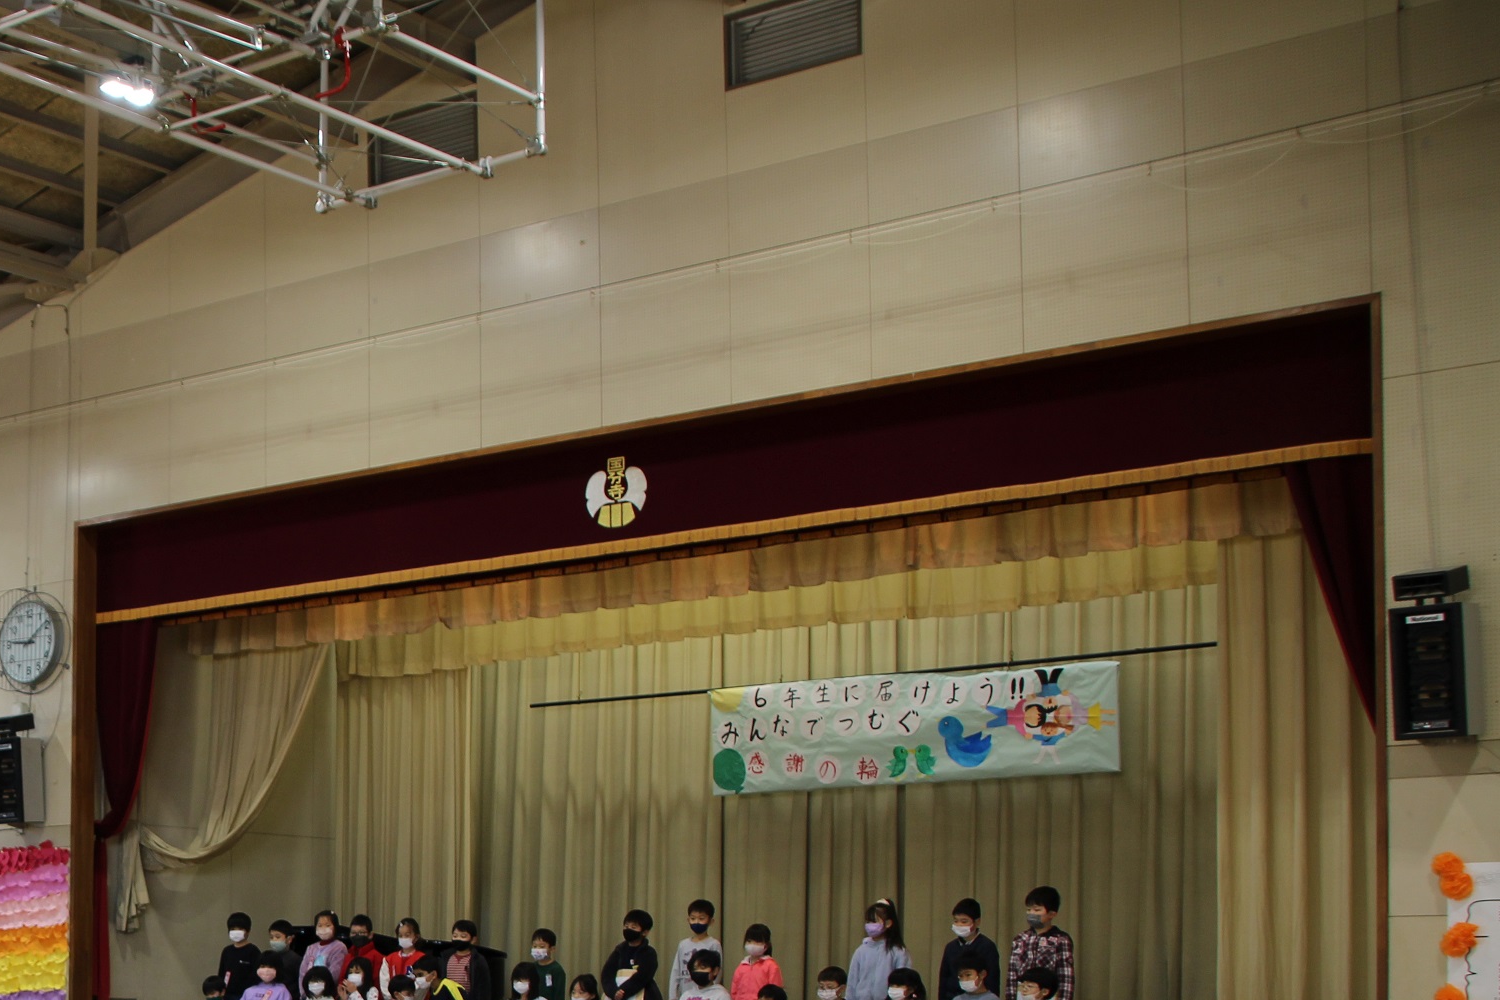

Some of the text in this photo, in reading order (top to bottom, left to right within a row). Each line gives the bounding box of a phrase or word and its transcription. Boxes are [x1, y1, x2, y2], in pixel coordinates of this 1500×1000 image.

[721, 709, 919, 745] みんなでつむぐ
[748, 752, 879, 780] 感謝の輪
